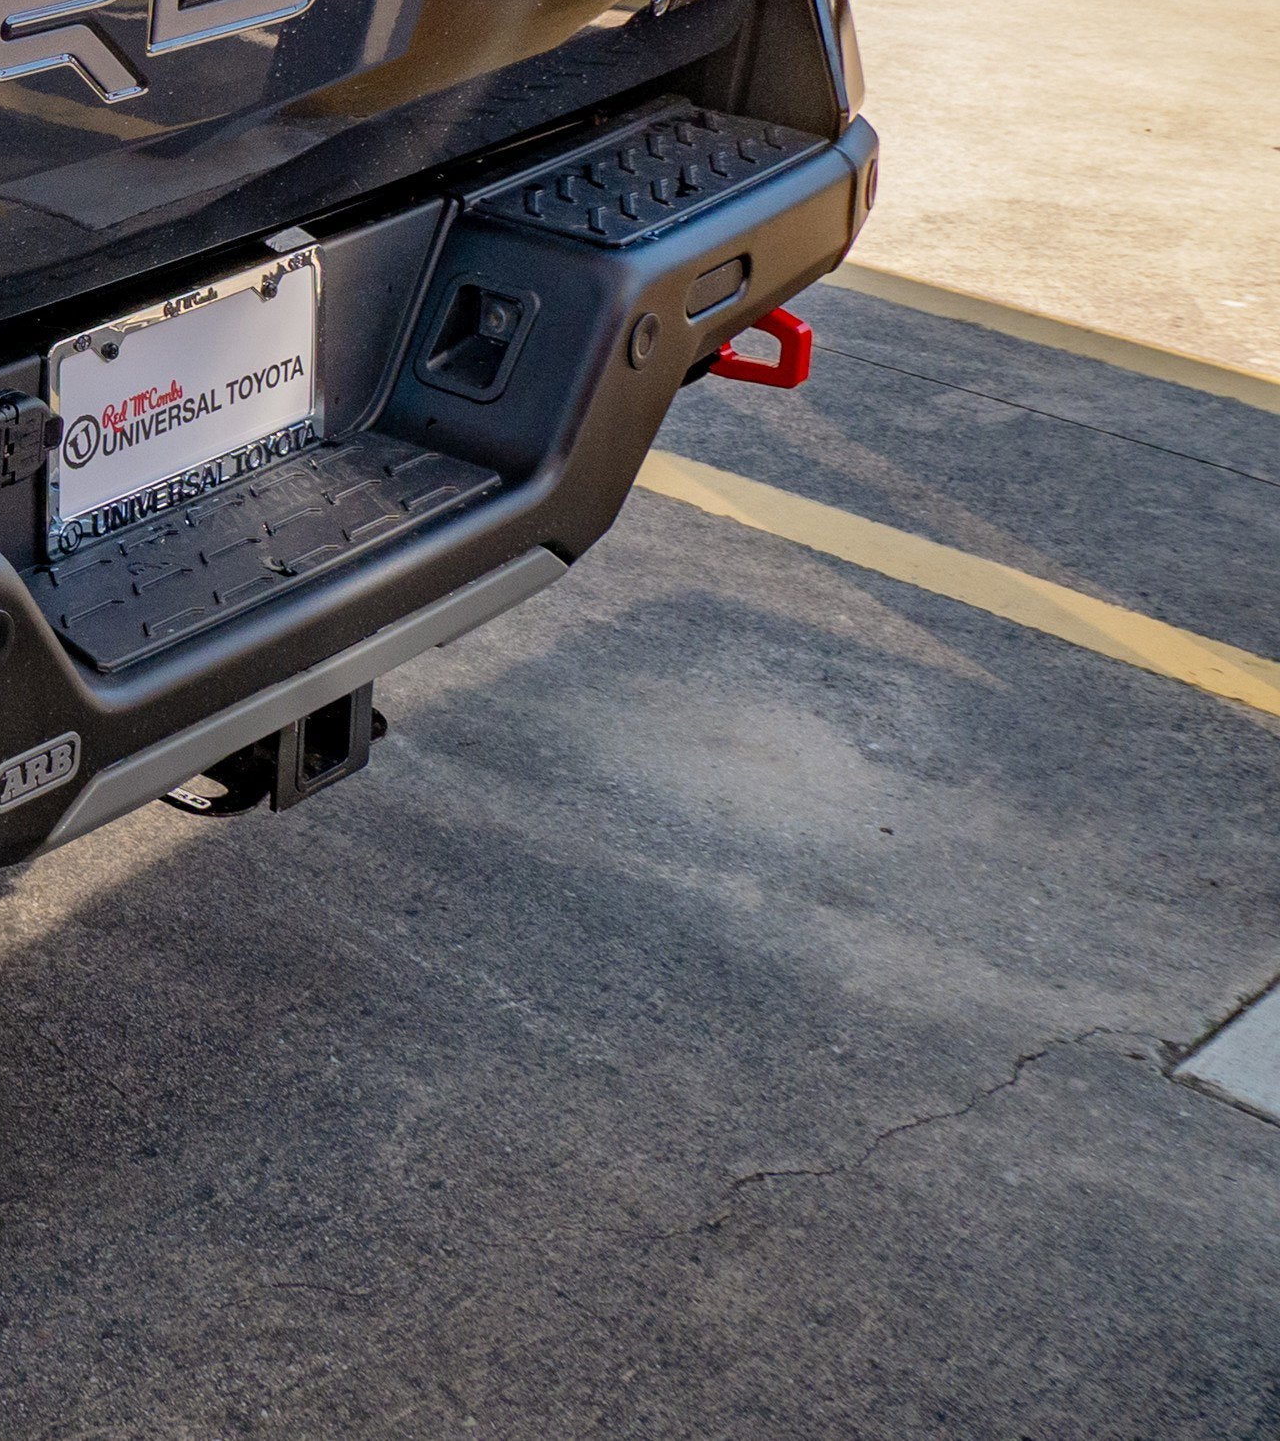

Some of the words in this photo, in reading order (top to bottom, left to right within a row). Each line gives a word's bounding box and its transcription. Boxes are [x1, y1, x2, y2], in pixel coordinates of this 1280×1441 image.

[102, 398, 128, 433] Red
[131, 379, 183, 417] McCombs
[102, 388, 222, 457] UNIVERSAL
[226, 355, 304, 406] TOYOTA
[91, 461, 231, 537] UNIVERSAL
[231, 420, 316, 478] TOYOTA
[0, 744, 72, 805] ARB
